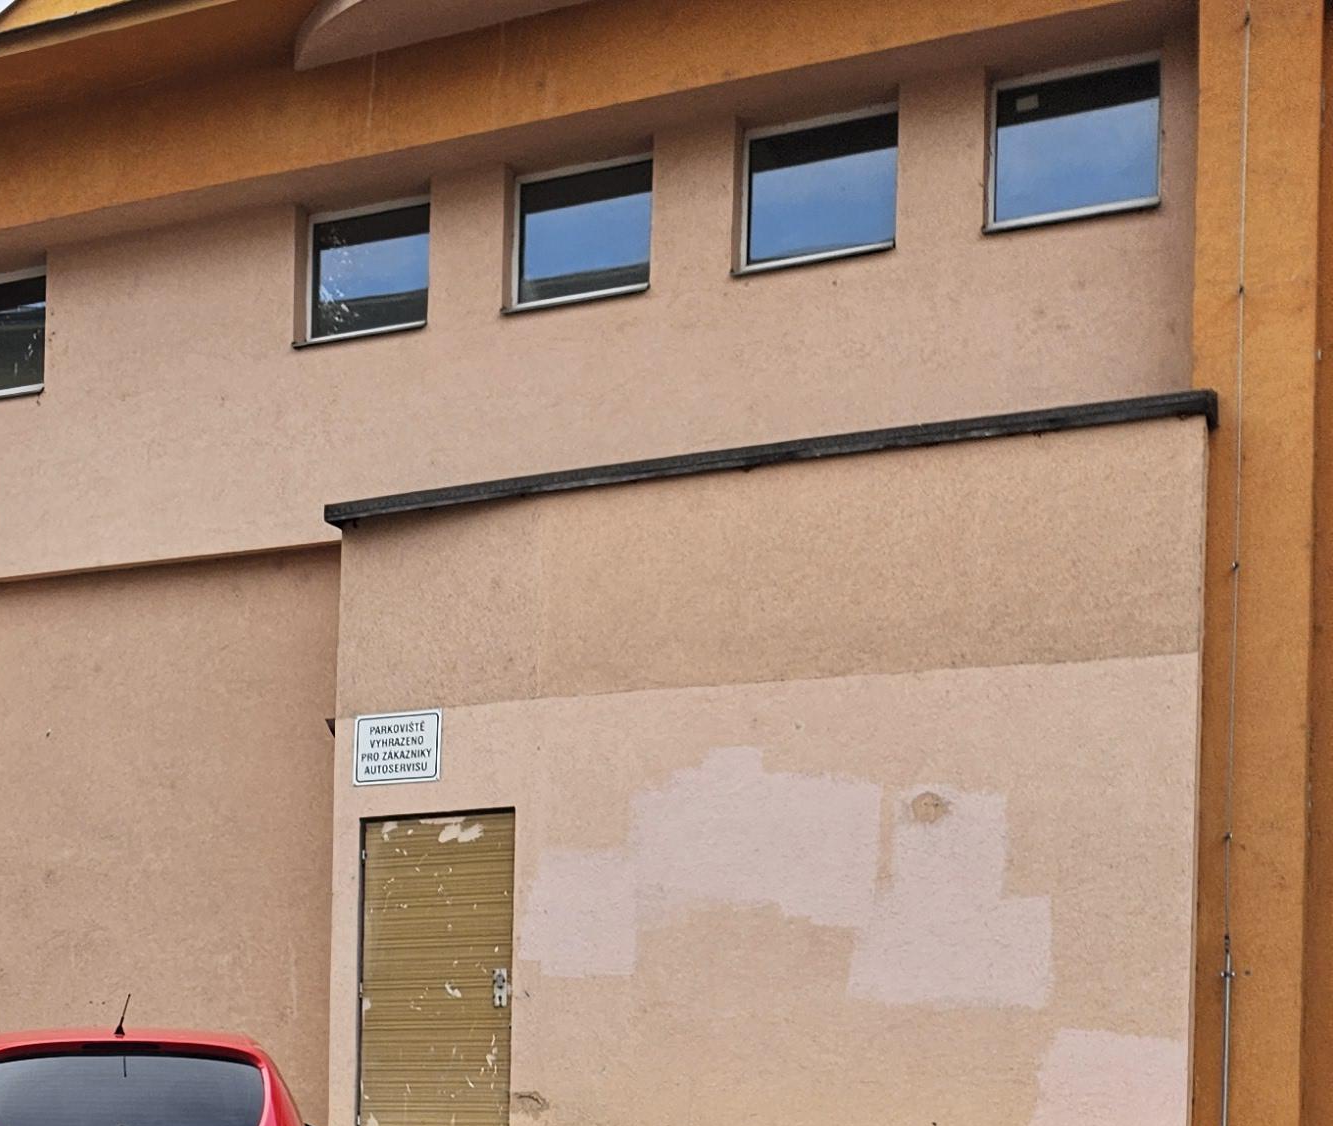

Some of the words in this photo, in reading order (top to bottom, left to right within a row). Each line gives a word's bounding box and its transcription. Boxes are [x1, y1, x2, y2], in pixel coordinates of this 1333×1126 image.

[369, 735, 424, 748] VYHRAZENO
[361, 752, 380, 762] PRO
[364, 761, 428, 775] AUTOSERVISU
